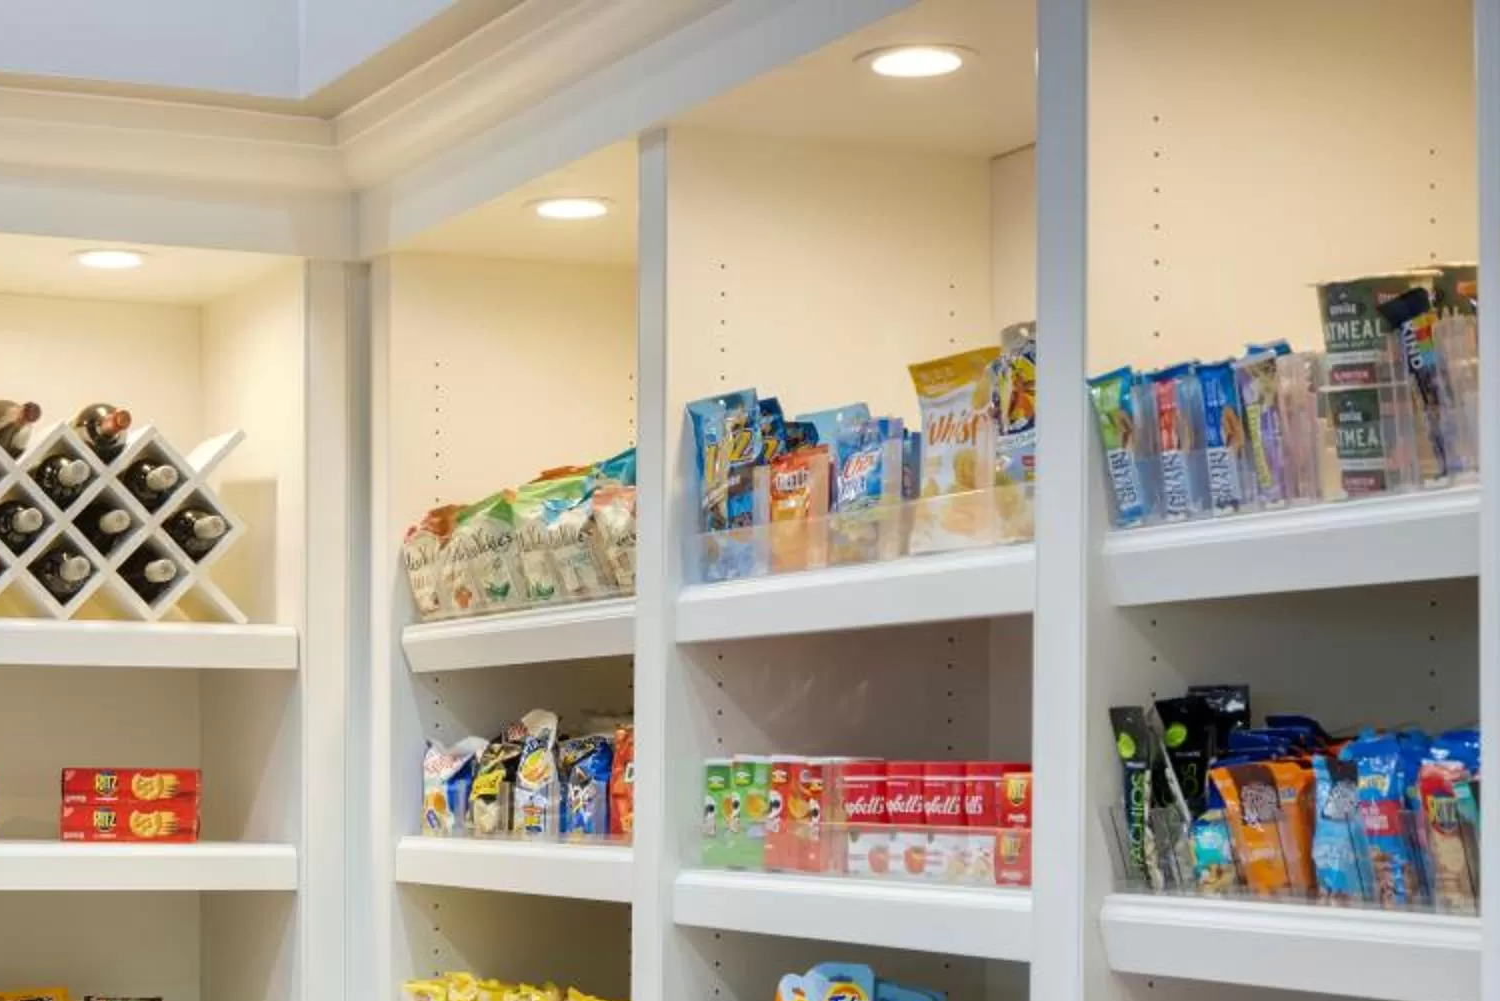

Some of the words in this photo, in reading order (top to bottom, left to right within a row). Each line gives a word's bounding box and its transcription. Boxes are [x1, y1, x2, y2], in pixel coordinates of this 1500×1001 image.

[1327, 317, 1385, 341] TMEAL
[1401, 319, 1424, 370] KIND
[1336, 427, 1380, 448] TMEA
